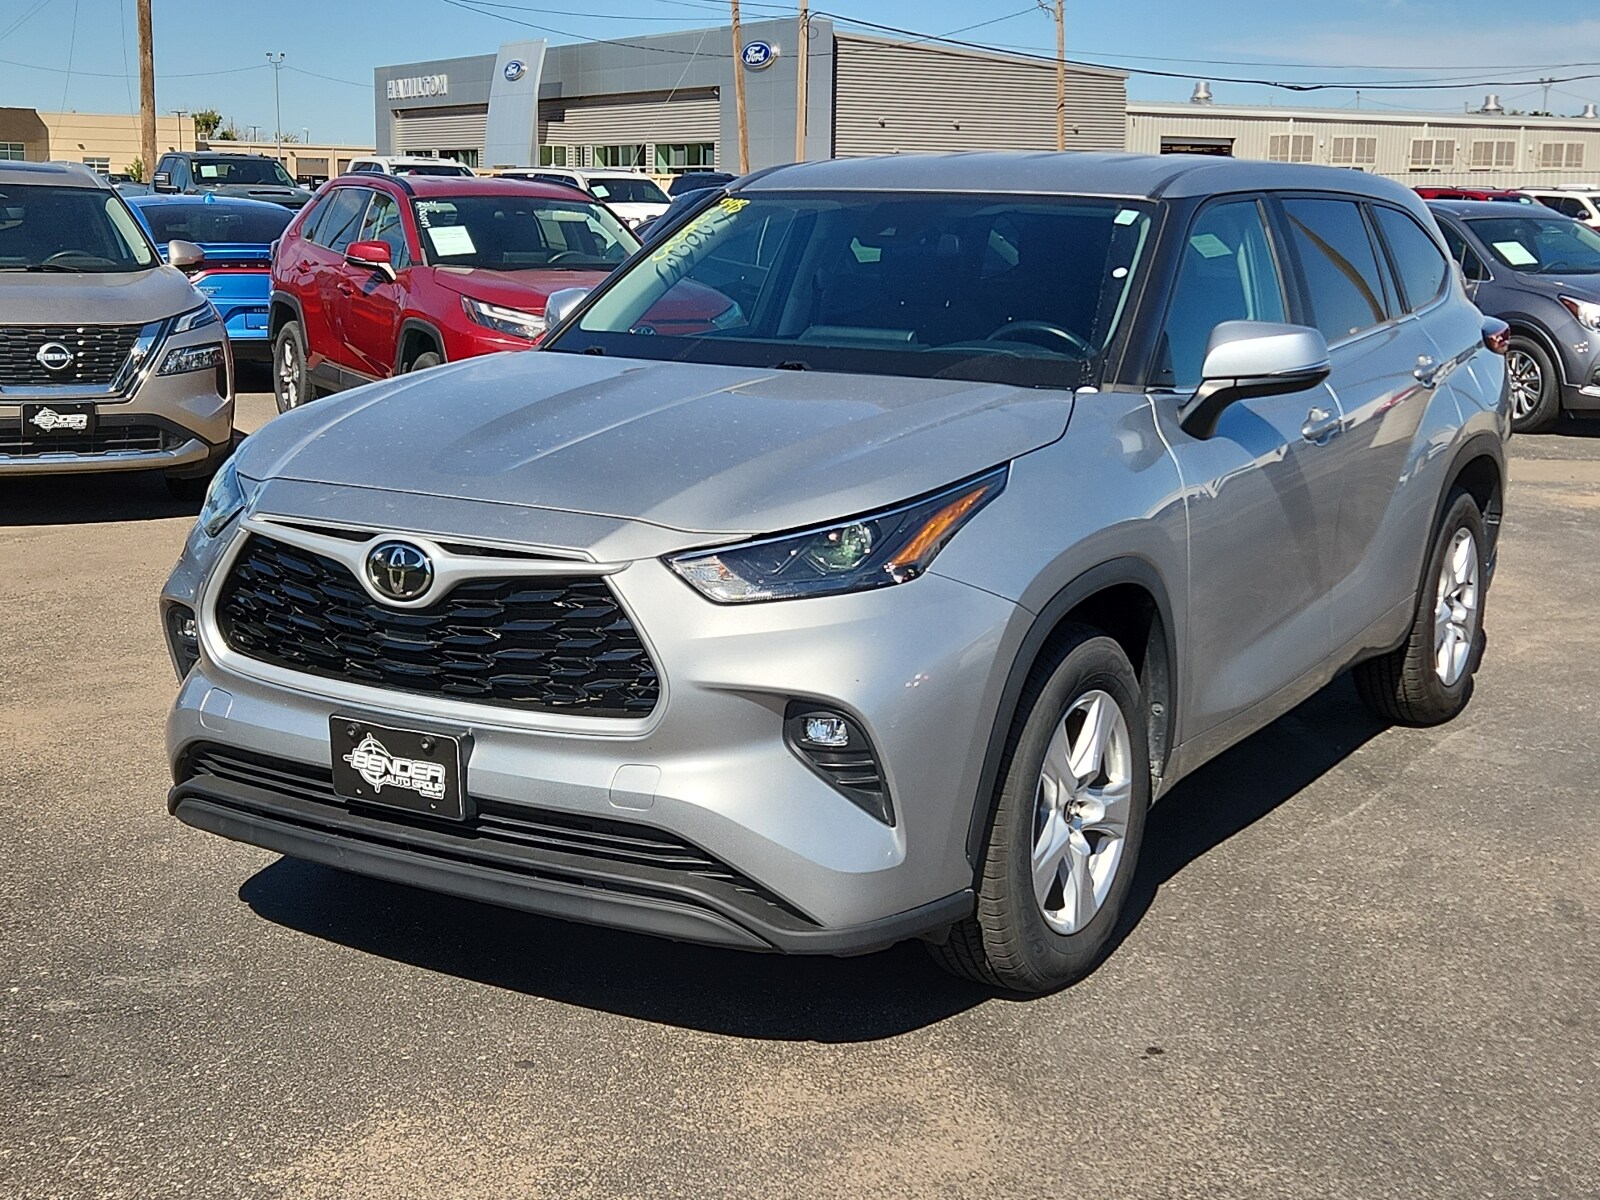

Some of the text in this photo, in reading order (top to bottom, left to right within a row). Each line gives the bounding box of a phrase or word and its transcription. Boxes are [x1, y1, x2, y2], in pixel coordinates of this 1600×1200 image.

[386, 74, 448, 99] HAMILTON
[36, 353, 74, 361] NISSAN
[353, 750, 444, 782] BENDER
[386, 774, 444, 792] AUTO GROUP
